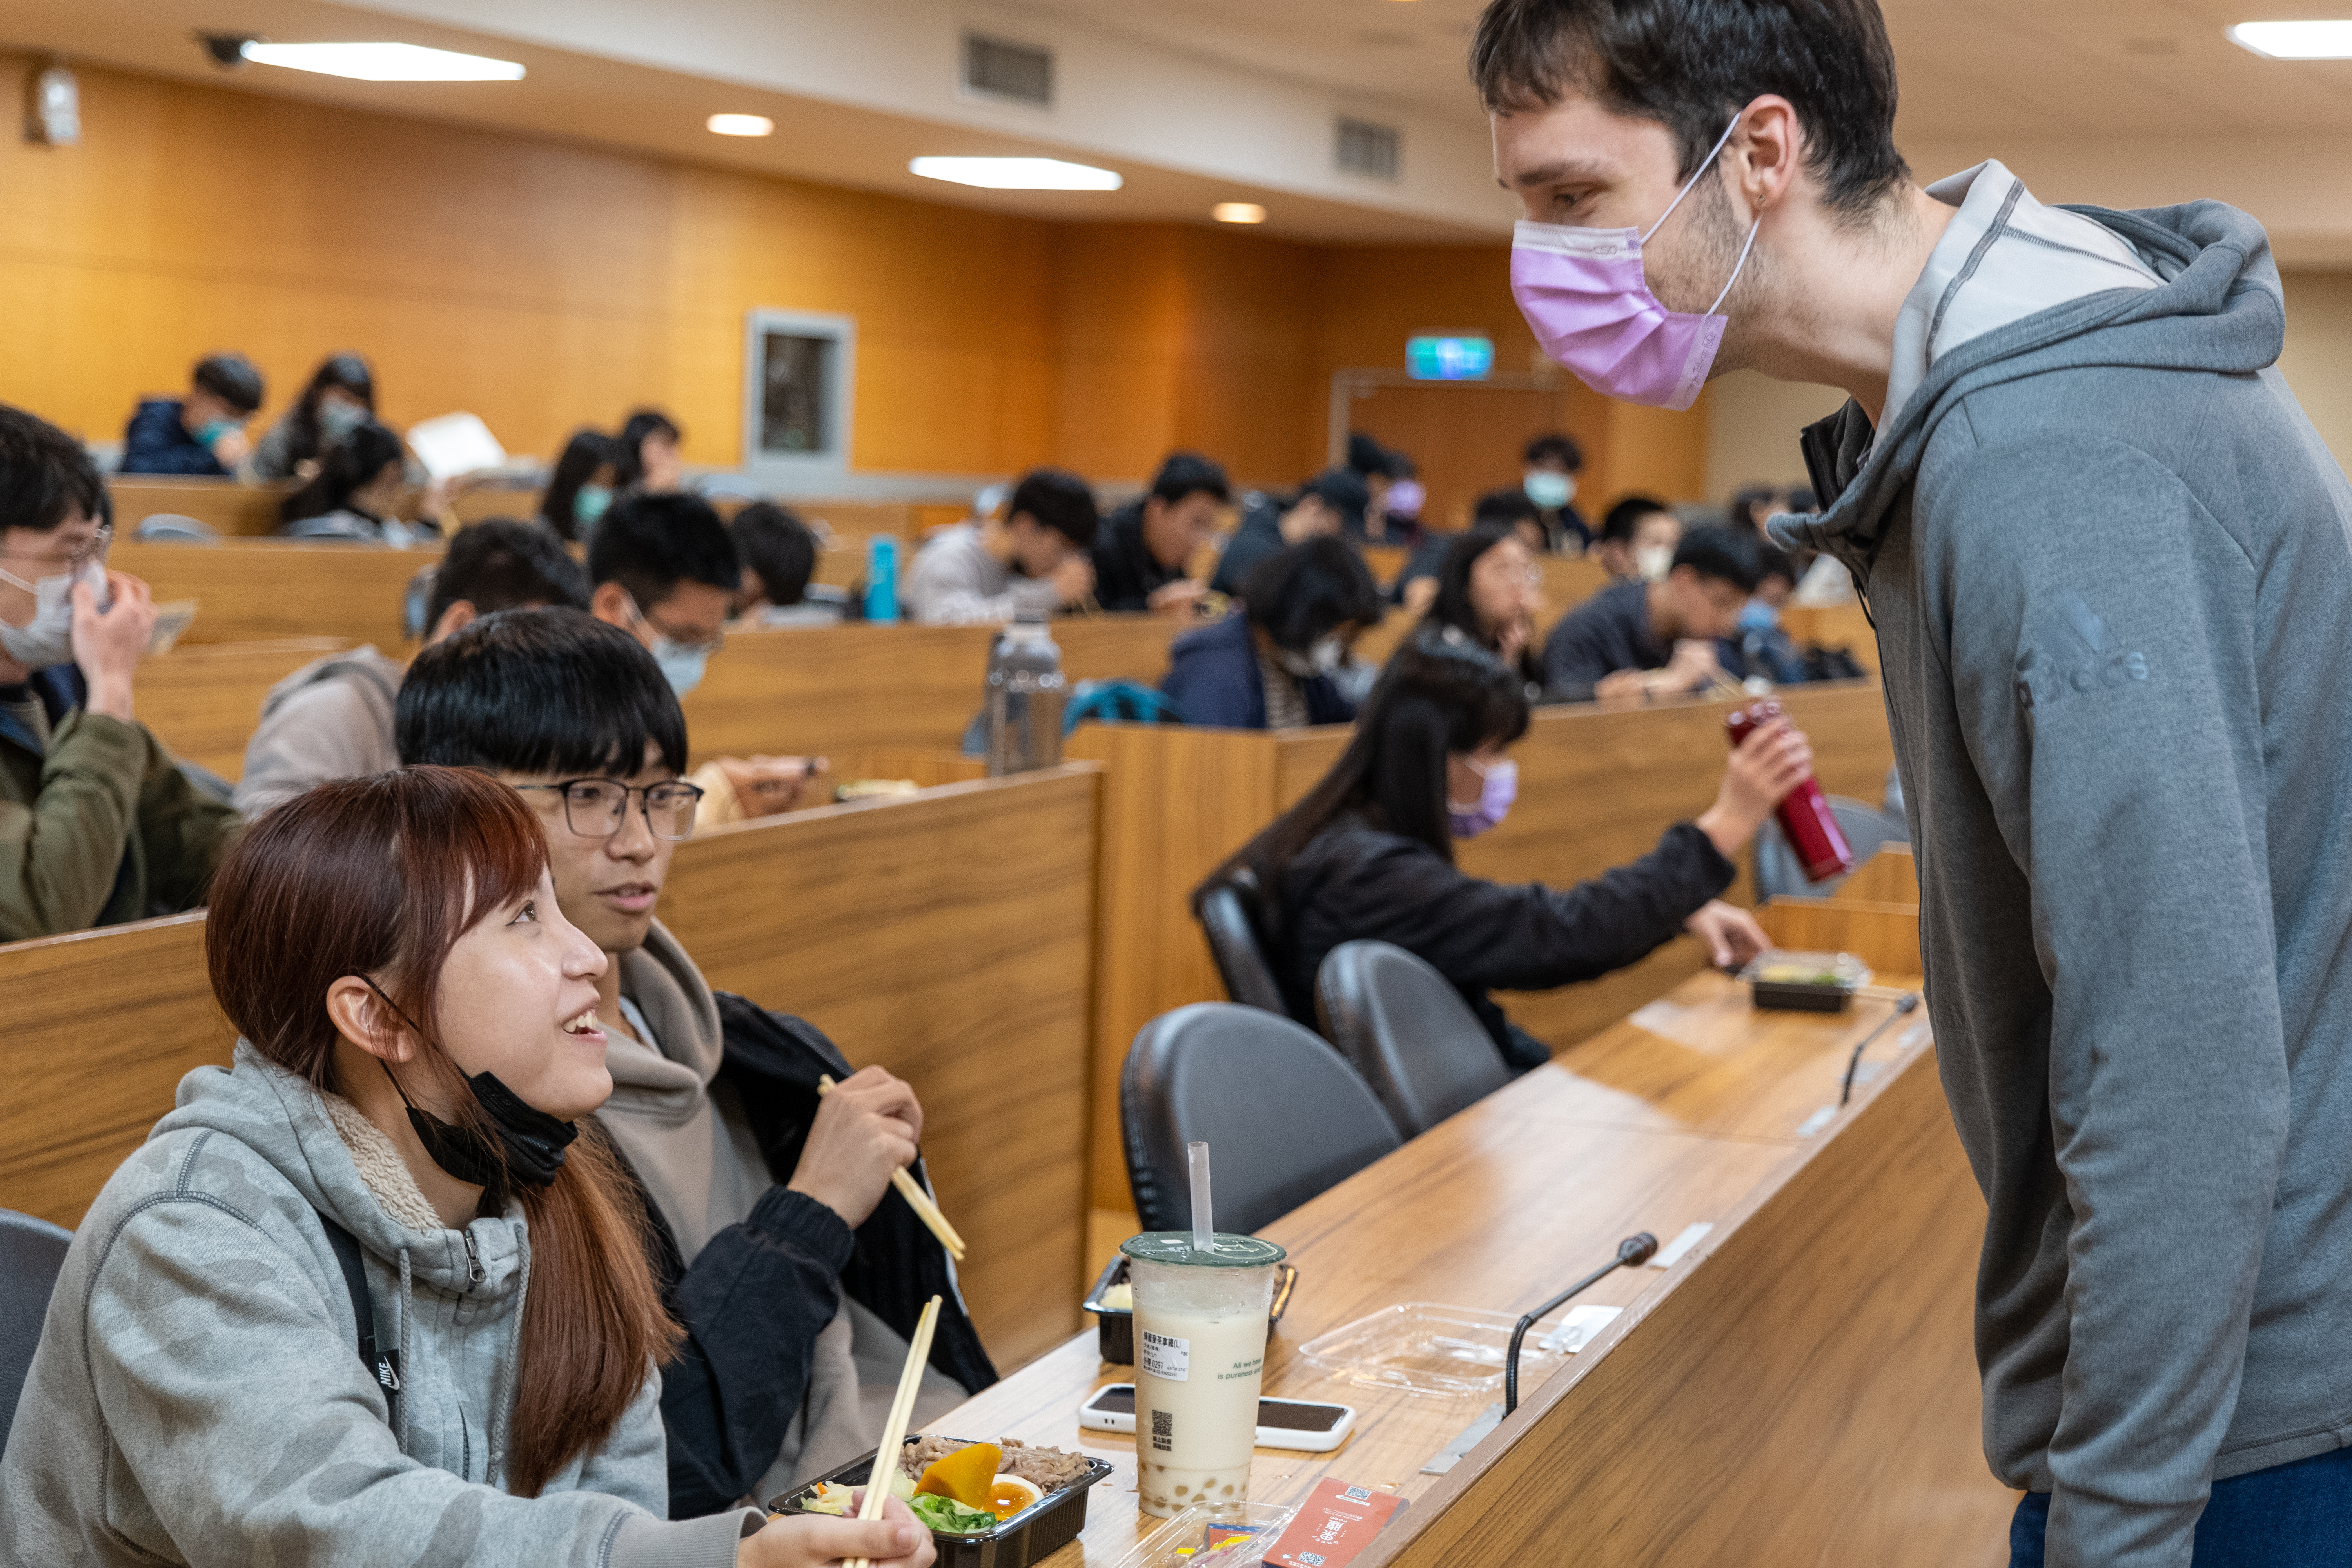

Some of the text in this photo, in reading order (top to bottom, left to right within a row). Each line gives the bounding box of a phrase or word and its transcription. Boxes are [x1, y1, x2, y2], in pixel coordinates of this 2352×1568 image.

[1152, 1360, 1163, 1369] 0297
[379, 1362, 392, 1385] NIKE
[1226, 1370, 1253, 1380] pureness
[1320, 1519, 1345, 1541] 果腹
